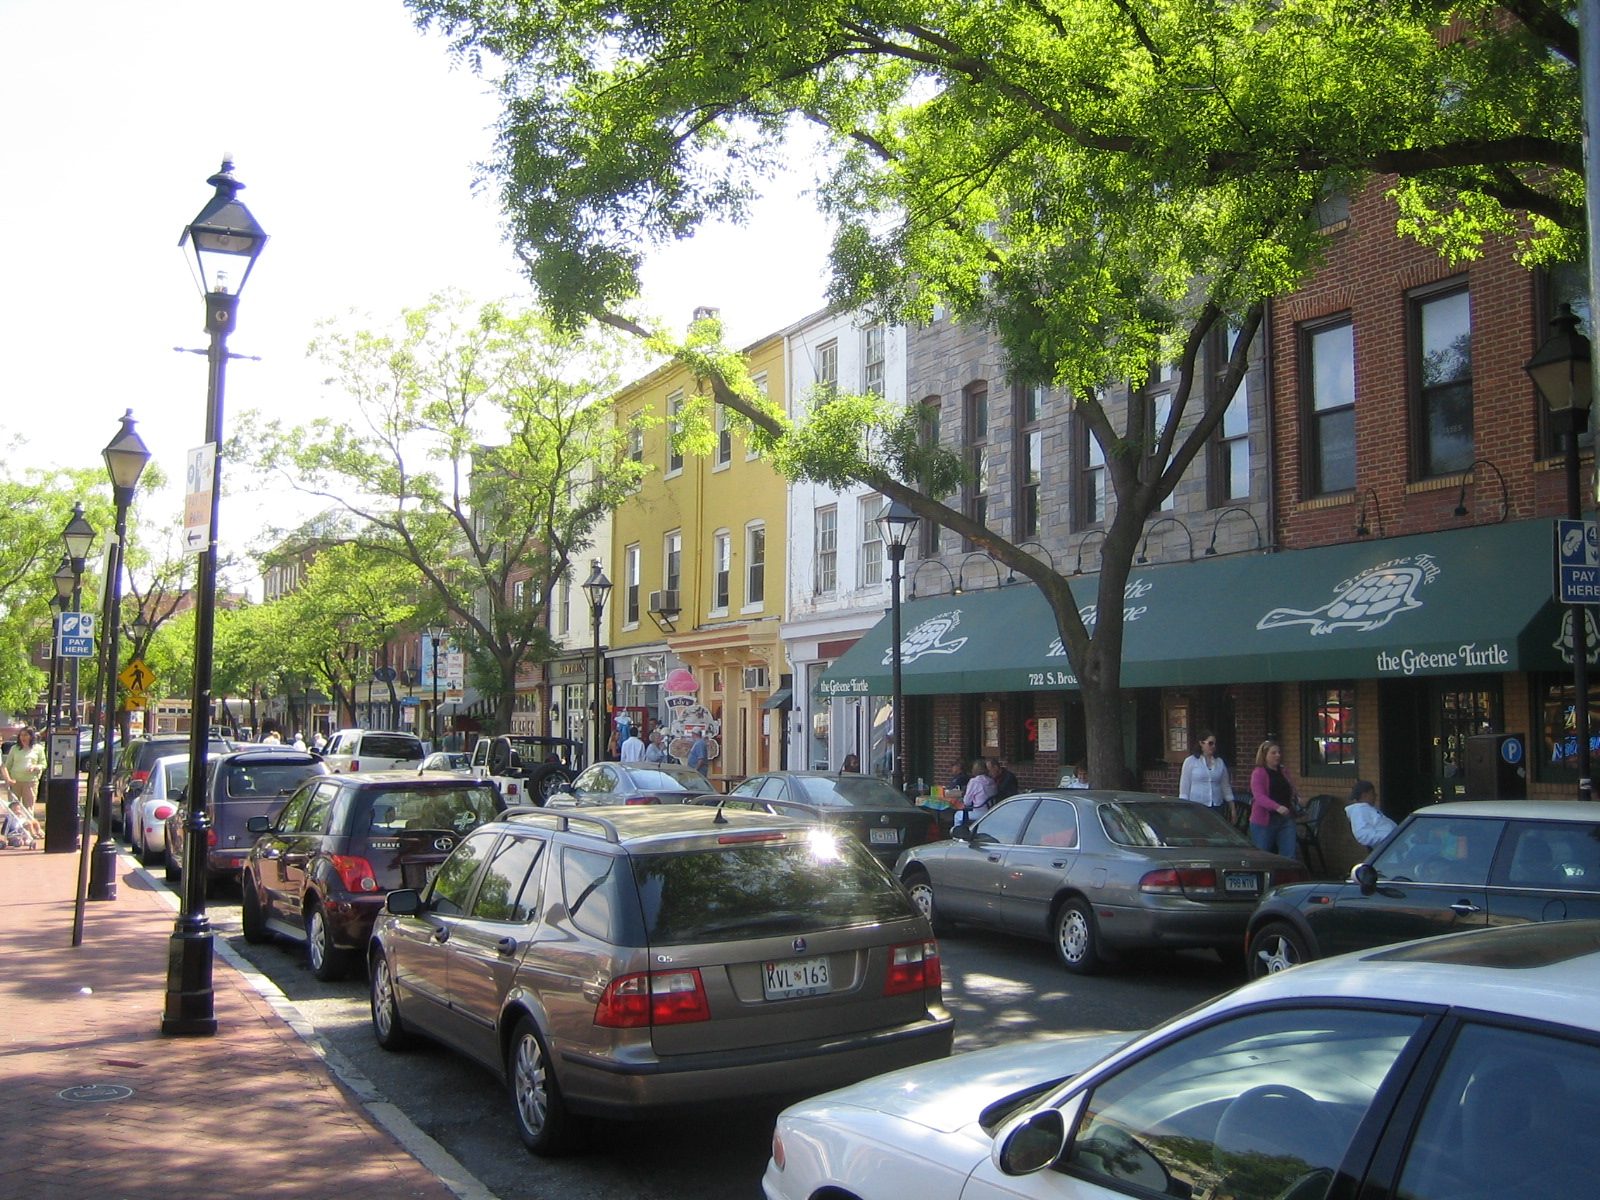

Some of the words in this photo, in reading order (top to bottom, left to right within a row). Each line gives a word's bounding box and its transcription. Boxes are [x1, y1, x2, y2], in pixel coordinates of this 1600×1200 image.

[1414, 553, 1441, 585] Turtle
[1572, 570, 1596, 582] PAY
[1567, 585, 1600, 596] HERE
[1376, 651, 1400, 671] the
[1401, 649, 1458, 675] Greene
[1458, 642, 1509, 667] Turtle
[820, 680, 830, 692] the
[829, 679, 851, 695] Greene
[850, 678, 869, 692] Turtle
[1028, 673, 1044, 686] 722
[1046, 672, 1057, 685] S.
[767, 968, 793, 989] KVL
[803, 965, 828, 985] 163
